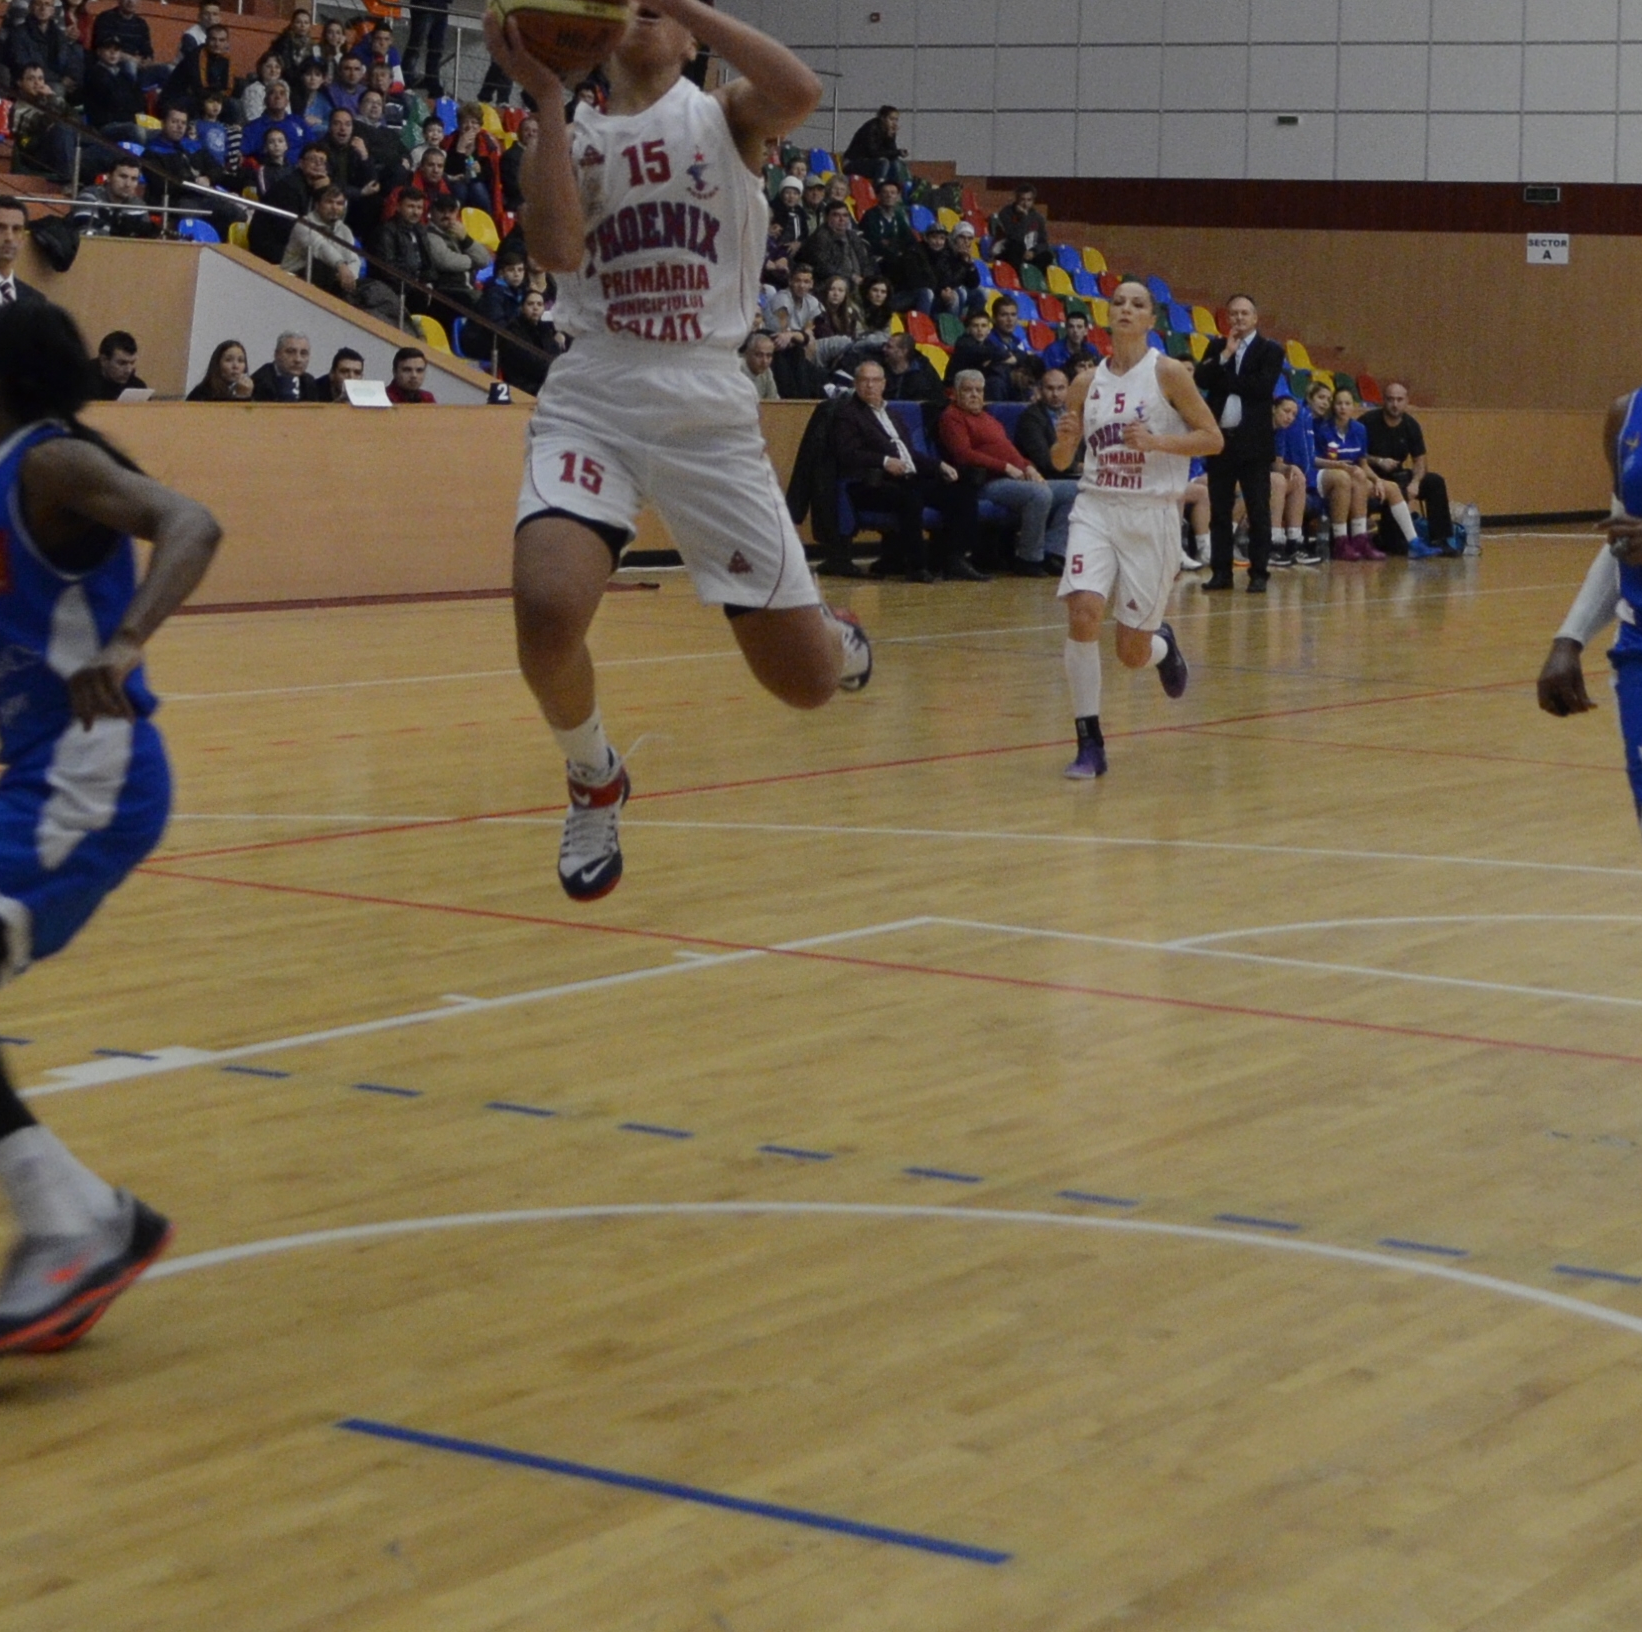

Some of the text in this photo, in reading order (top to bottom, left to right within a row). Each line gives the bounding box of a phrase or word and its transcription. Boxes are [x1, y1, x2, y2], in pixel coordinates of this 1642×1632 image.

[621, 139, 672, 187] 15
[585, 200, 721, 279] PHOENIX
[1528, 239, 1568, 248] SECTOR
[1542, 250, 1552, 261] A
[600, 261, 711, 299] PRIMĂRIA
[497, 383, 509, 400] 2
[1114, 392, 1125, 414] 5
[559, 451, 605, 495] 15
[1072, 555, 1083, 575] 5
